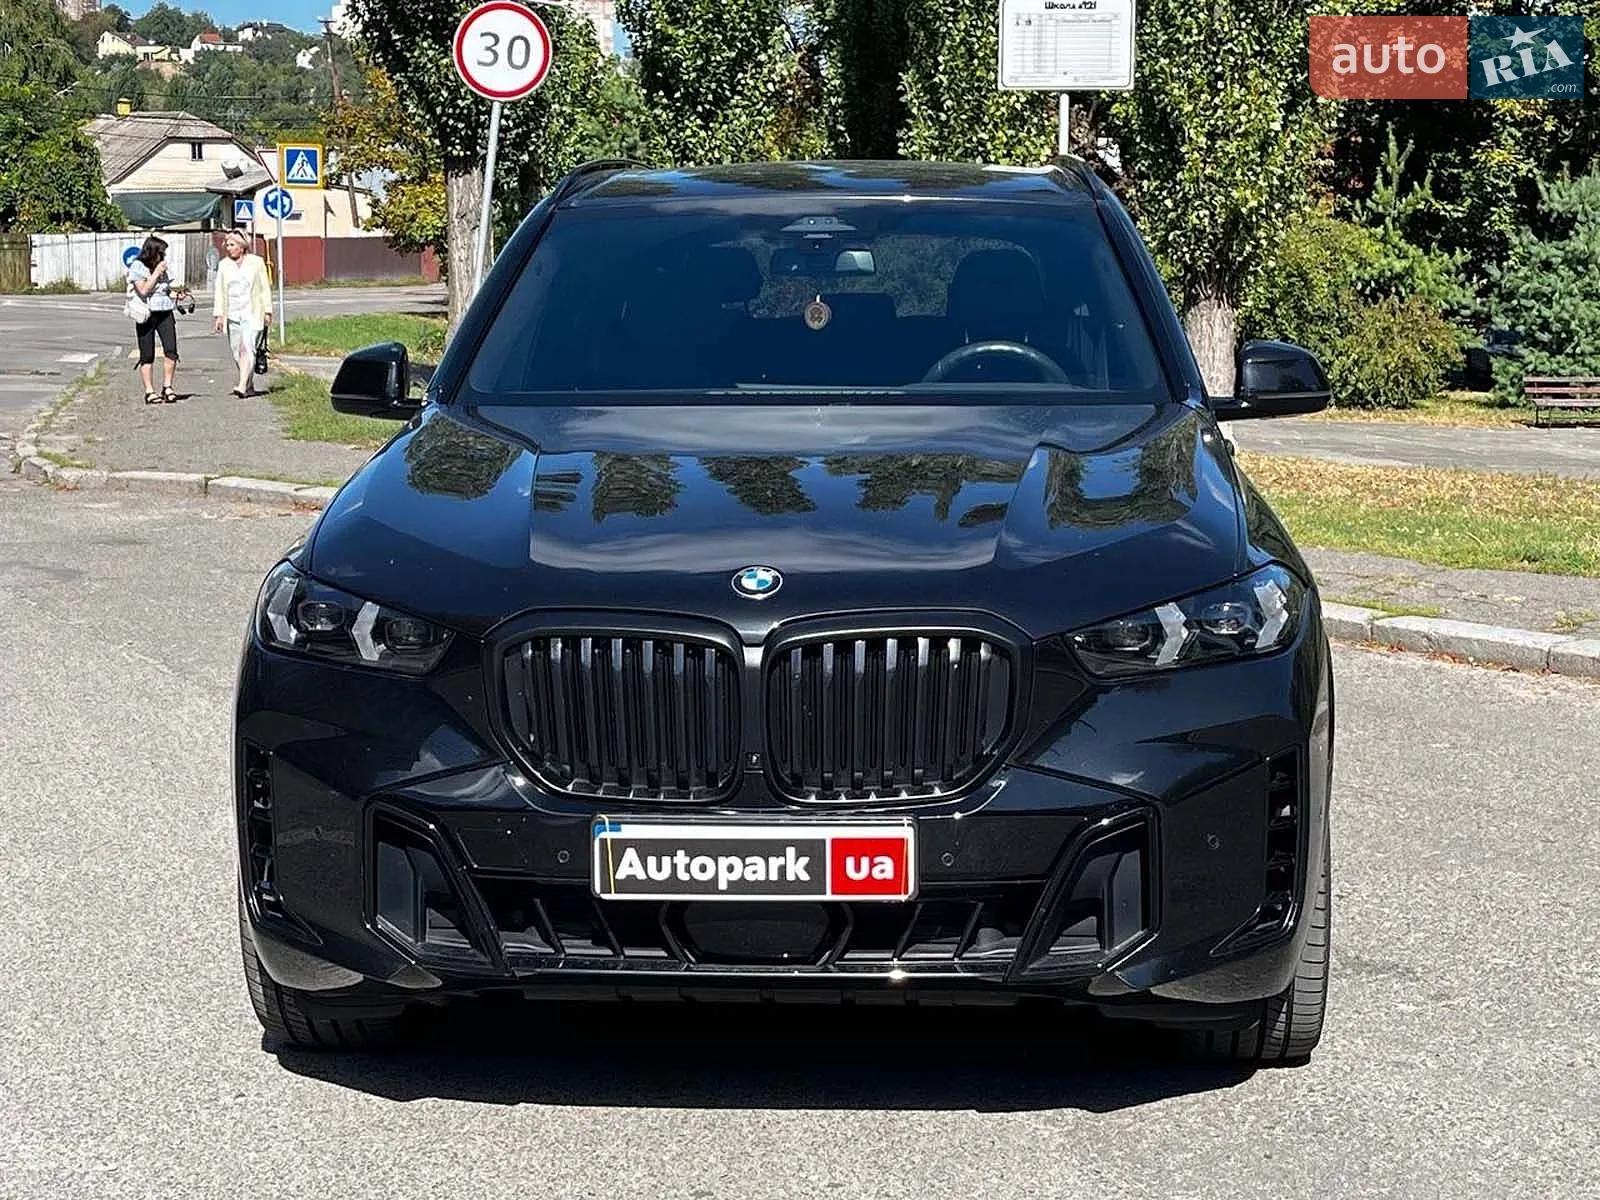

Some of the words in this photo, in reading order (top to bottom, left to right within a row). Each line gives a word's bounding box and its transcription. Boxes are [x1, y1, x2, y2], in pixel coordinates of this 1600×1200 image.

[1044, 1, 1076, 10] Школа
[476, 31, 531, 70] 30
[615, 845, 810, 890] Autopark
[845, 854, 894, 881] ua
